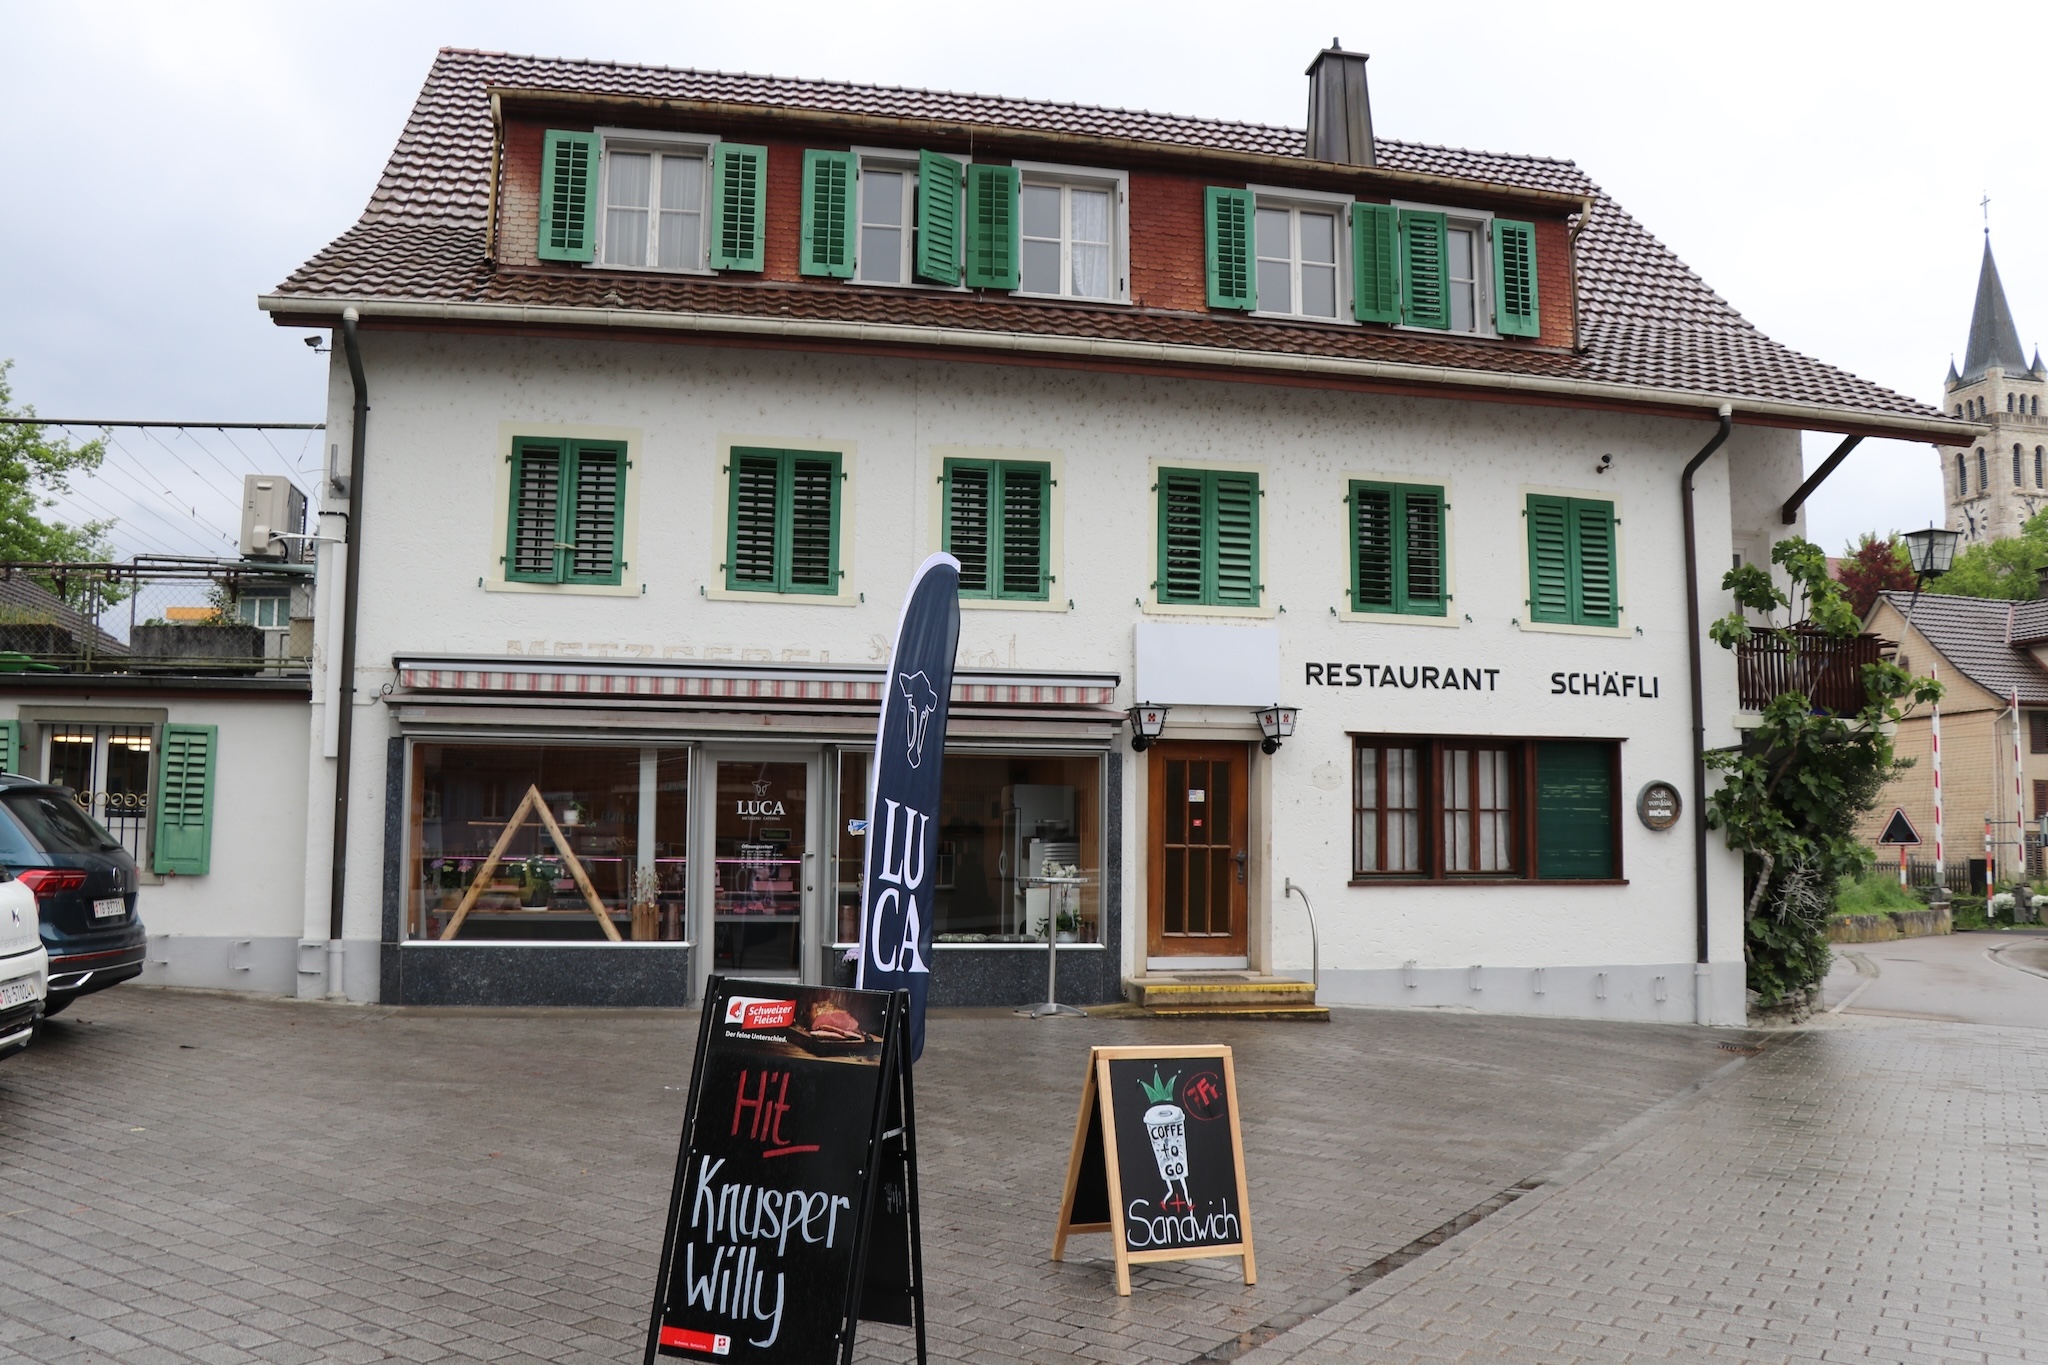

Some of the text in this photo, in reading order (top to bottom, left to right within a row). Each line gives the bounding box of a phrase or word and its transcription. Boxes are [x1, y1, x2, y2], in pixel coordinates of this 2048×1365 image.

[1306, 662, 1659, 698] RESTAURANT SCHÄFLI
[736, 800, 786, 816] LUCA
[878, 798, 929, 890] LU
[871, 888, 930, 973] CA
[748, 1005, 792, 1016] Schweizer
[753, 1015, 783, 1025] Fleisch
[725, 1030, 788, 1043] Der feine Unterschied.
[730, 1069, 791, 1146] Hit
[1151, 1123, 1184, 1140] COFFE
[1161, 1144, 1179, 1160] to
[1165, 1163, 1184, 1177] GO
[691, 1154, 851, 1258] Knusper
[1127, 1197, 1240, 1247] Sandwich
[686, 1241, 785, 1348] Willy
